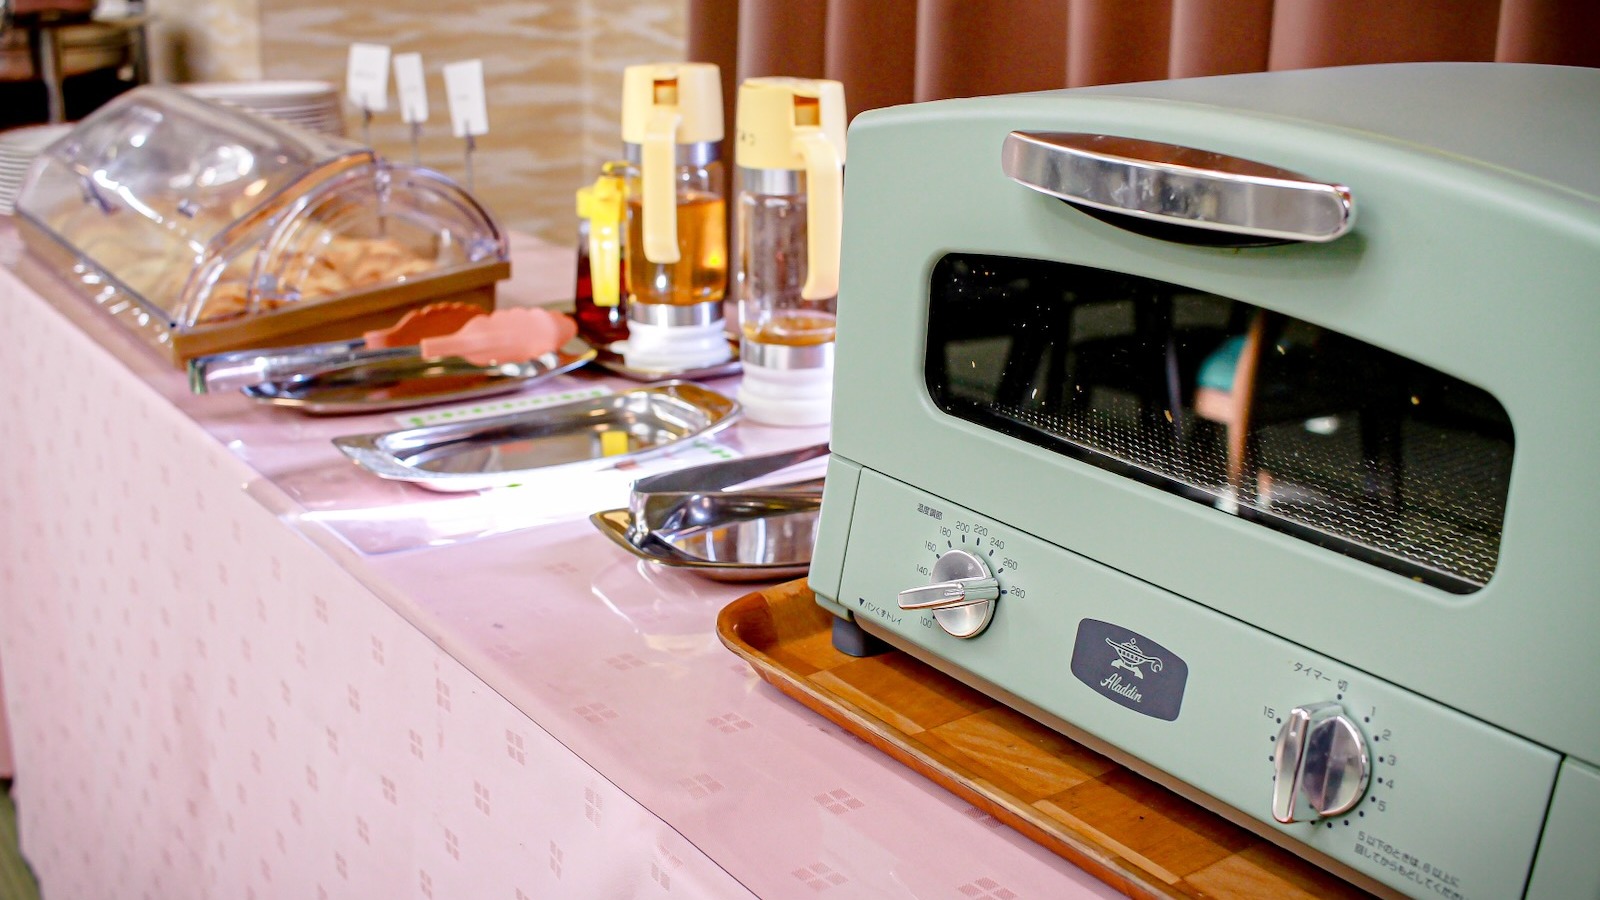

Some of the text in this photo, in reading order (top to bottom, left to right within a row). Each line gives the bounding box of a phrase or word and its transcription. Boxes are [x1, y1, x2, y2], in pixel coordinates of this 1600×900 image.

[939, 526, 951, 538] 180
[955, 520, 970, 534] 200
[973, 523, 988, 537] 220
[924, 540, 937, 552] 160
[990, 536, 1004, 550] 240
[916, 563, 928, 576] 140
[1003, 557, 1018, 570] 260
[1010, 585, 1025, 599] 280
[920, 616, 932, 628] 100
[1293, 661, 1332, 681] タイマー
[1100, 673, 1142, 703] Aladdin
[1263, 705, 1275, 719] 15
[1371, 706, 1377, 717] 1
[1381, 729, 1392, 741] 2
[1387, 754, 1397, 767] 3
[1385, 779, 1395, 789] 4
[1377, 800, 1387, 812] 5
